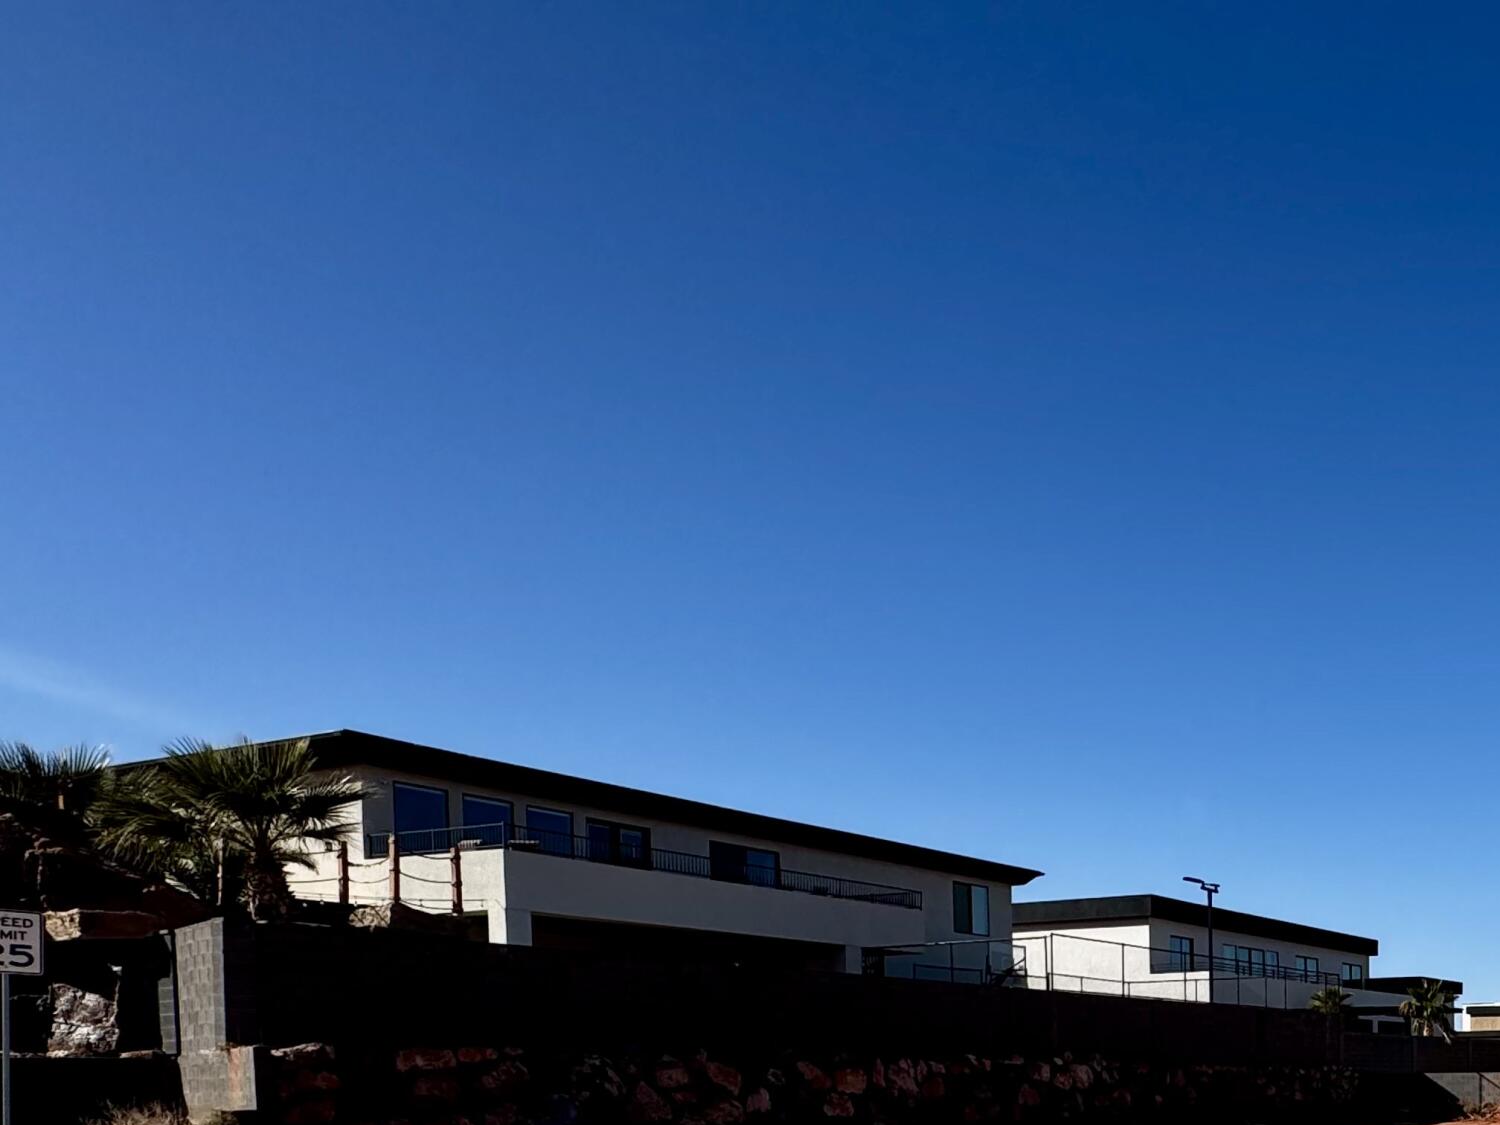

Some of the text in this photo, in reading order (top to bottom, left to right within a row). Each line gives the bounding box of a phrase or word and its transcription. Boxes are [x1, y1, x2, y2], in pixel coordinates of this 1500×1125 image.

[0, 916, 34, 929] EED
[0, 929, 28, 941] MIT
[0, 943, 35, 968] 5
